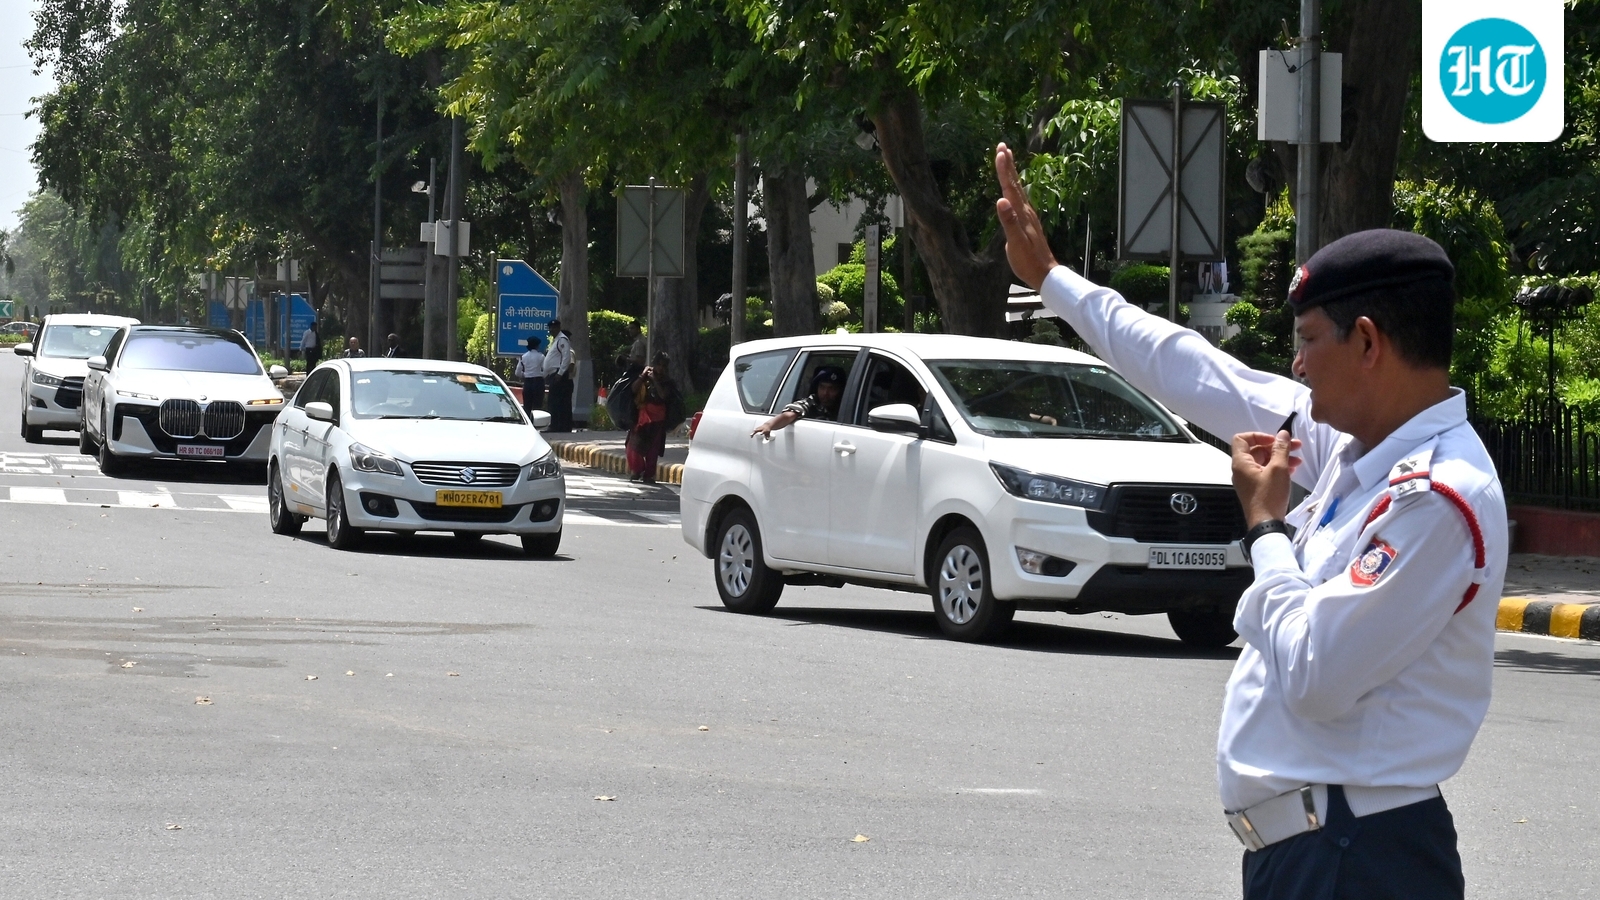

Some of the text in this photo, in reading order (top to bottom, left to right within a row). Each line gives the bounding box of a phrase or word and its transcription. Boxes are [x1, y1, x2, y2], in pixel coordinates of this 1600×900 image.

[505, 306, 552, 318] ली-मेरीडियन
[502, 322, 512, 330] LE
[518, 322, 550, 331] MERIDIE
[179, 446, 188, 454] HR
[195, 447, 202, 455] TC
[443, 493, 500, 505] MH02ER4781
[1157, 551, 1225, 566] DL1CAG9059
